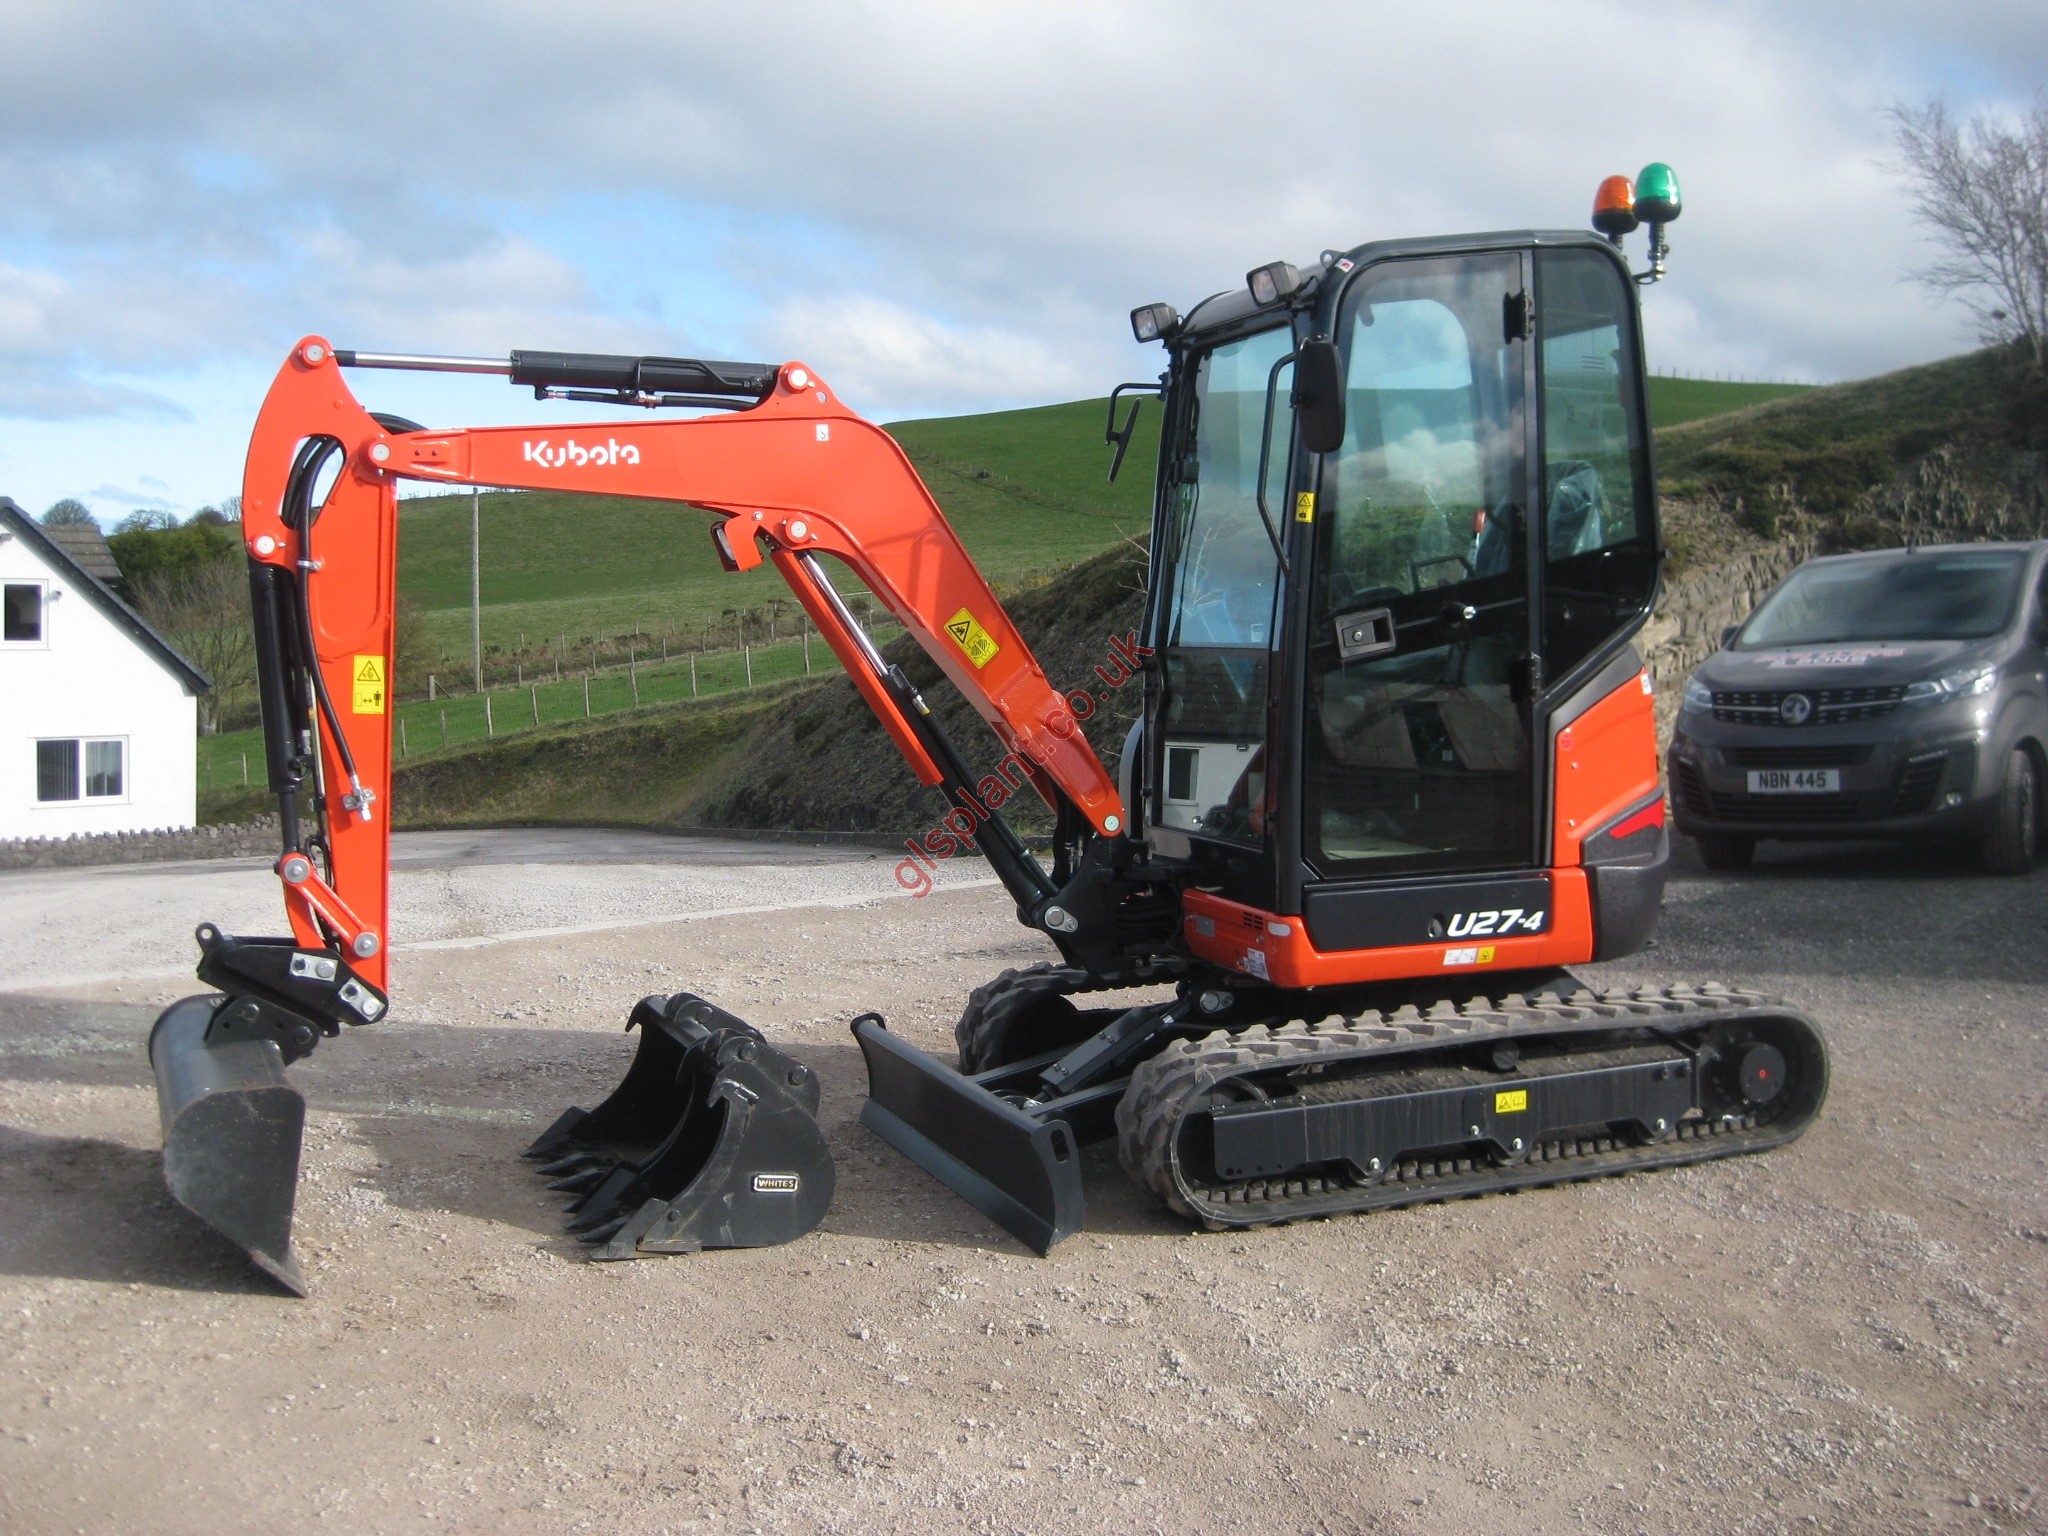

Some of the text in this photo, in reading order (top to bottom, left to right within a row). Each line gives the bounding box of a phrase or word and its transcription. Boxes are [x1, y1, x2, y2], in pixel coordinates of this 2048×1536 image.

[523, 438, 640, 467] Kubota
[1758, 772, 1826, 788] NBN 445
[1447, 908, 1544, 937] U27-4
[758, 1179, 794, 1188] WHITES
